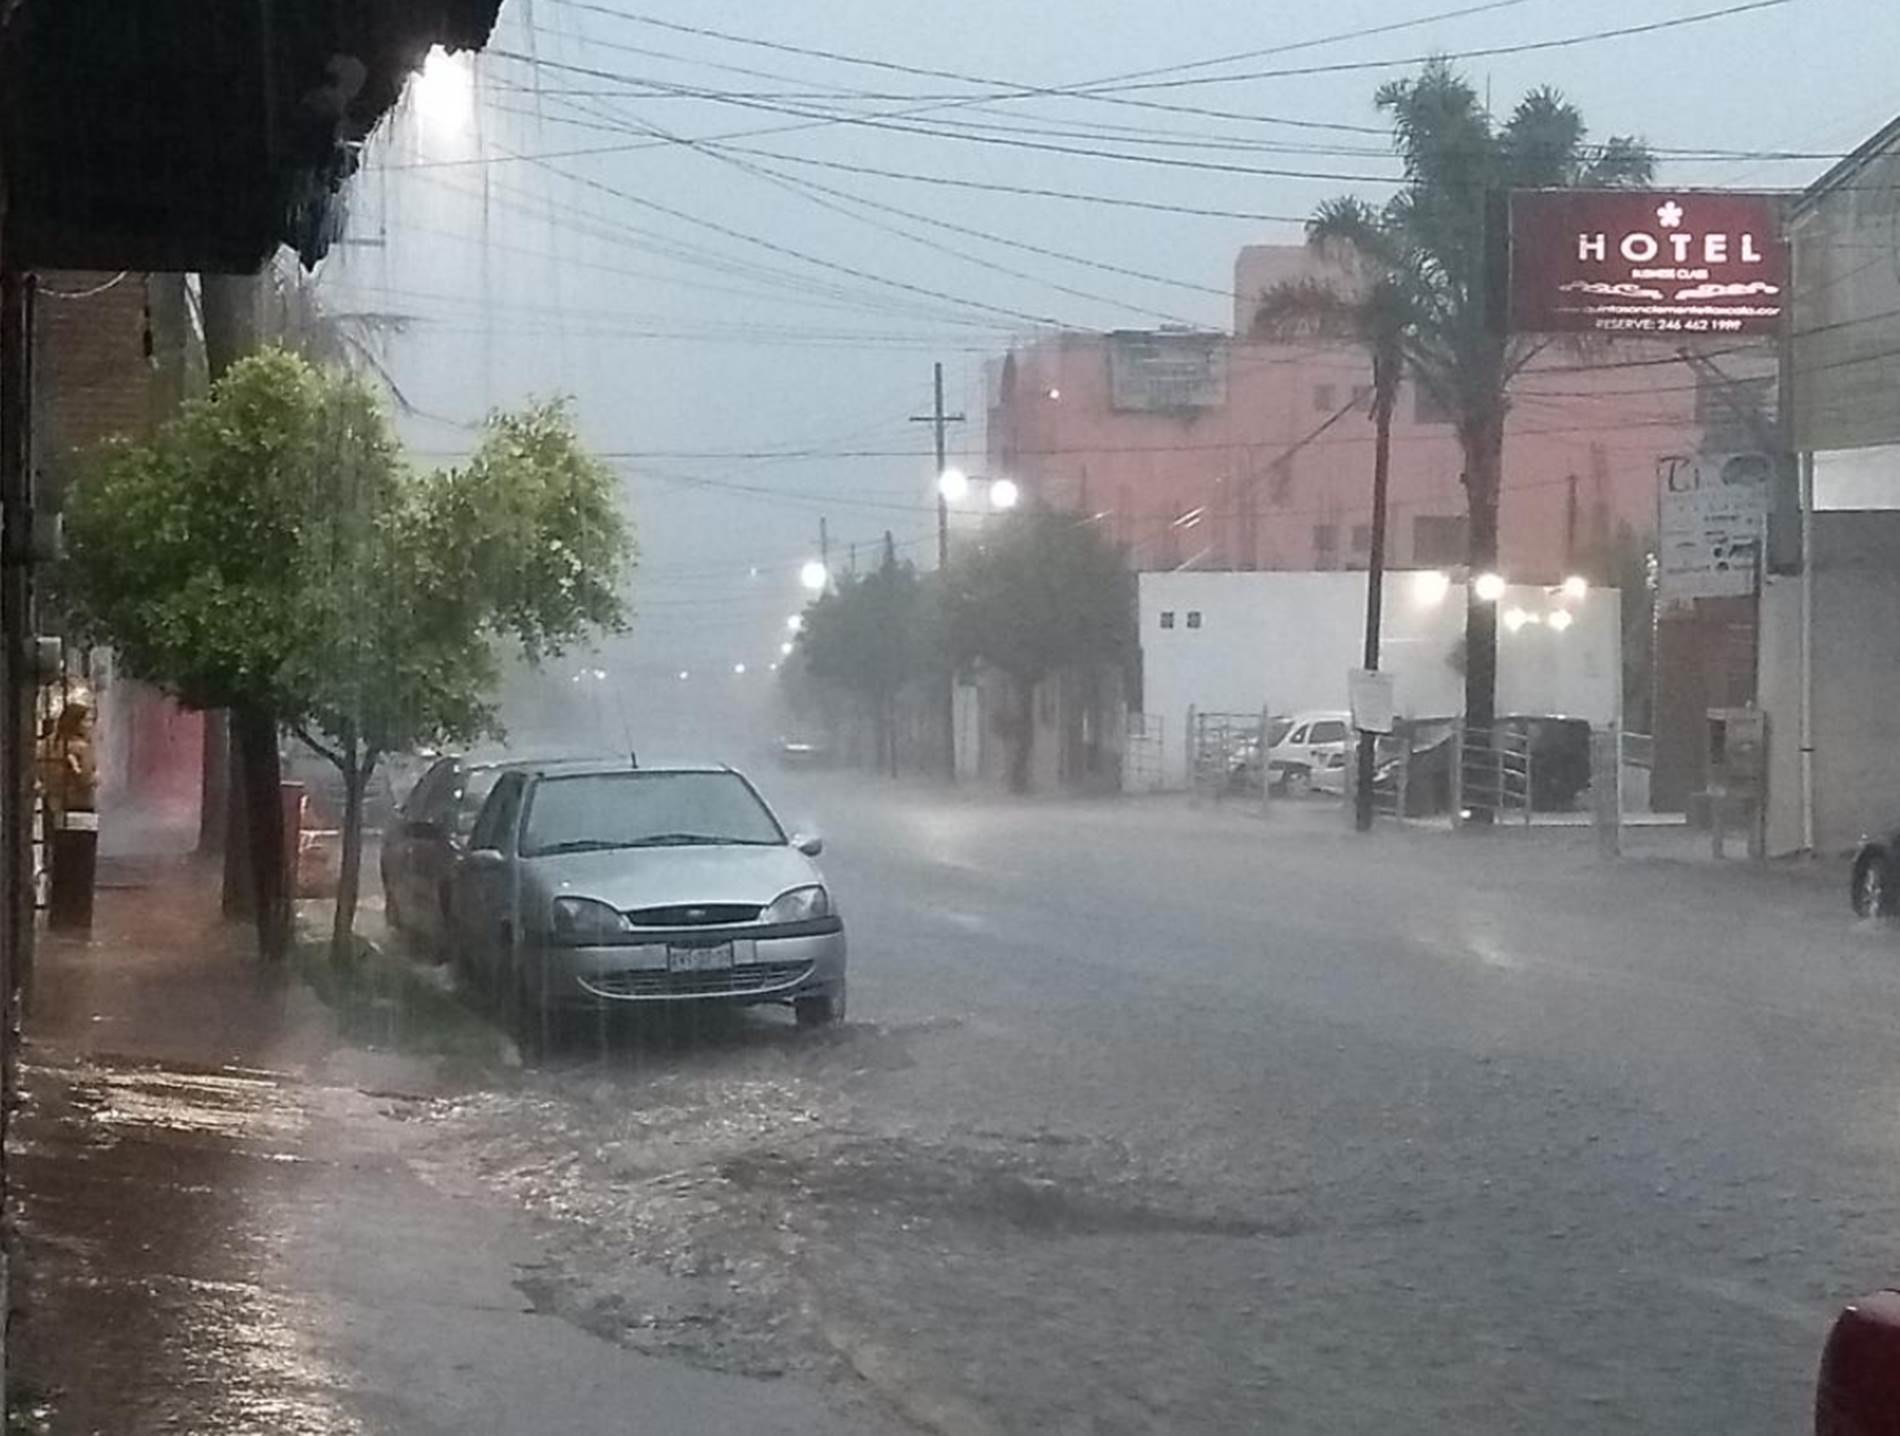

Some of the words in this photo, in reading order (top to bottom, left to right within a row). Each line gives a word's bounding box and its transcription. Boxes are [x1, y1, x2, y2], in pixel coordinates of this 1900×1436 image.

[1578, 233, 1762, 262] HOTEL
[1656, 319, 1682, 330] 246
[1683, 319, 1708, 330] 462
